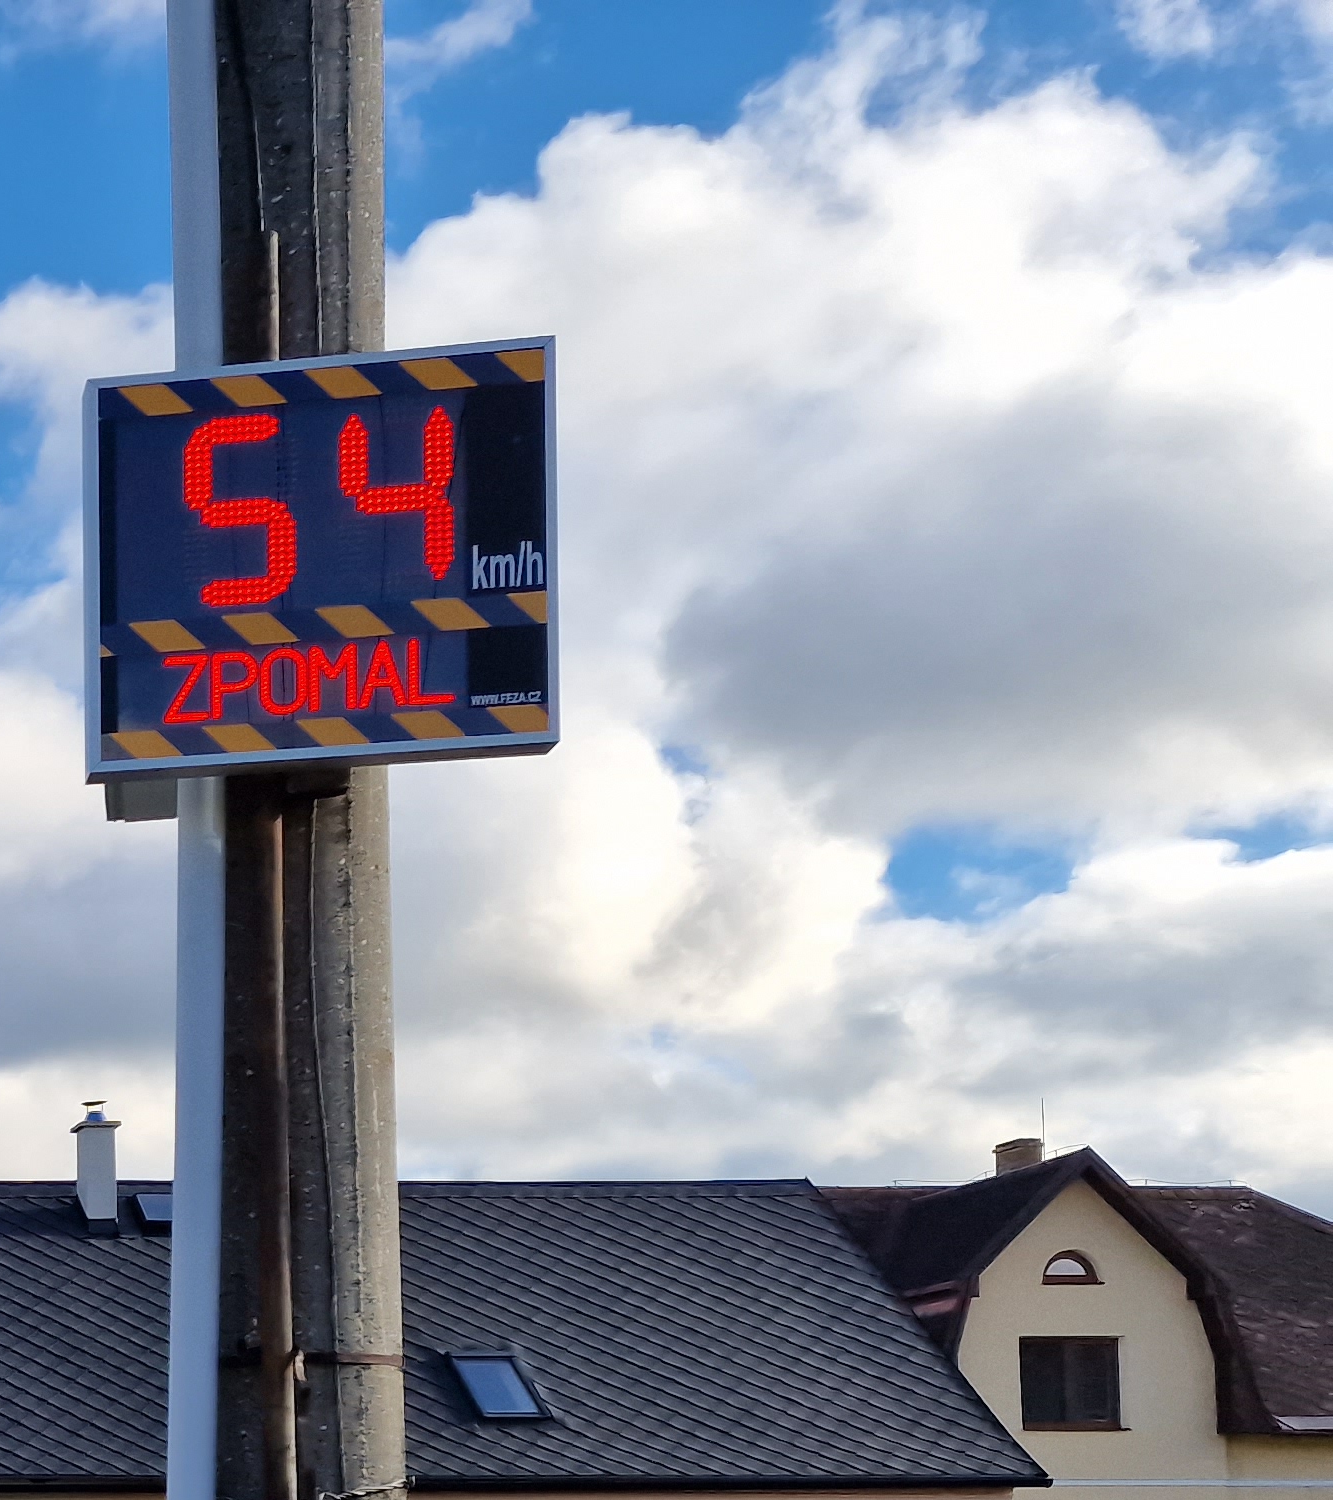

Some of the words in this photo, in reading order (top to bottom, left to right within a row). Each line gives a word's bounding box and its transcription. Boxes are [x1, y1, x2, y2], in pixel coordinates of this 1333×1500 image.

[183, 405, 454, 607] 54
[472, 540, 544, 589] km/h
[162, 637, 456, 724] ZPOMAL
